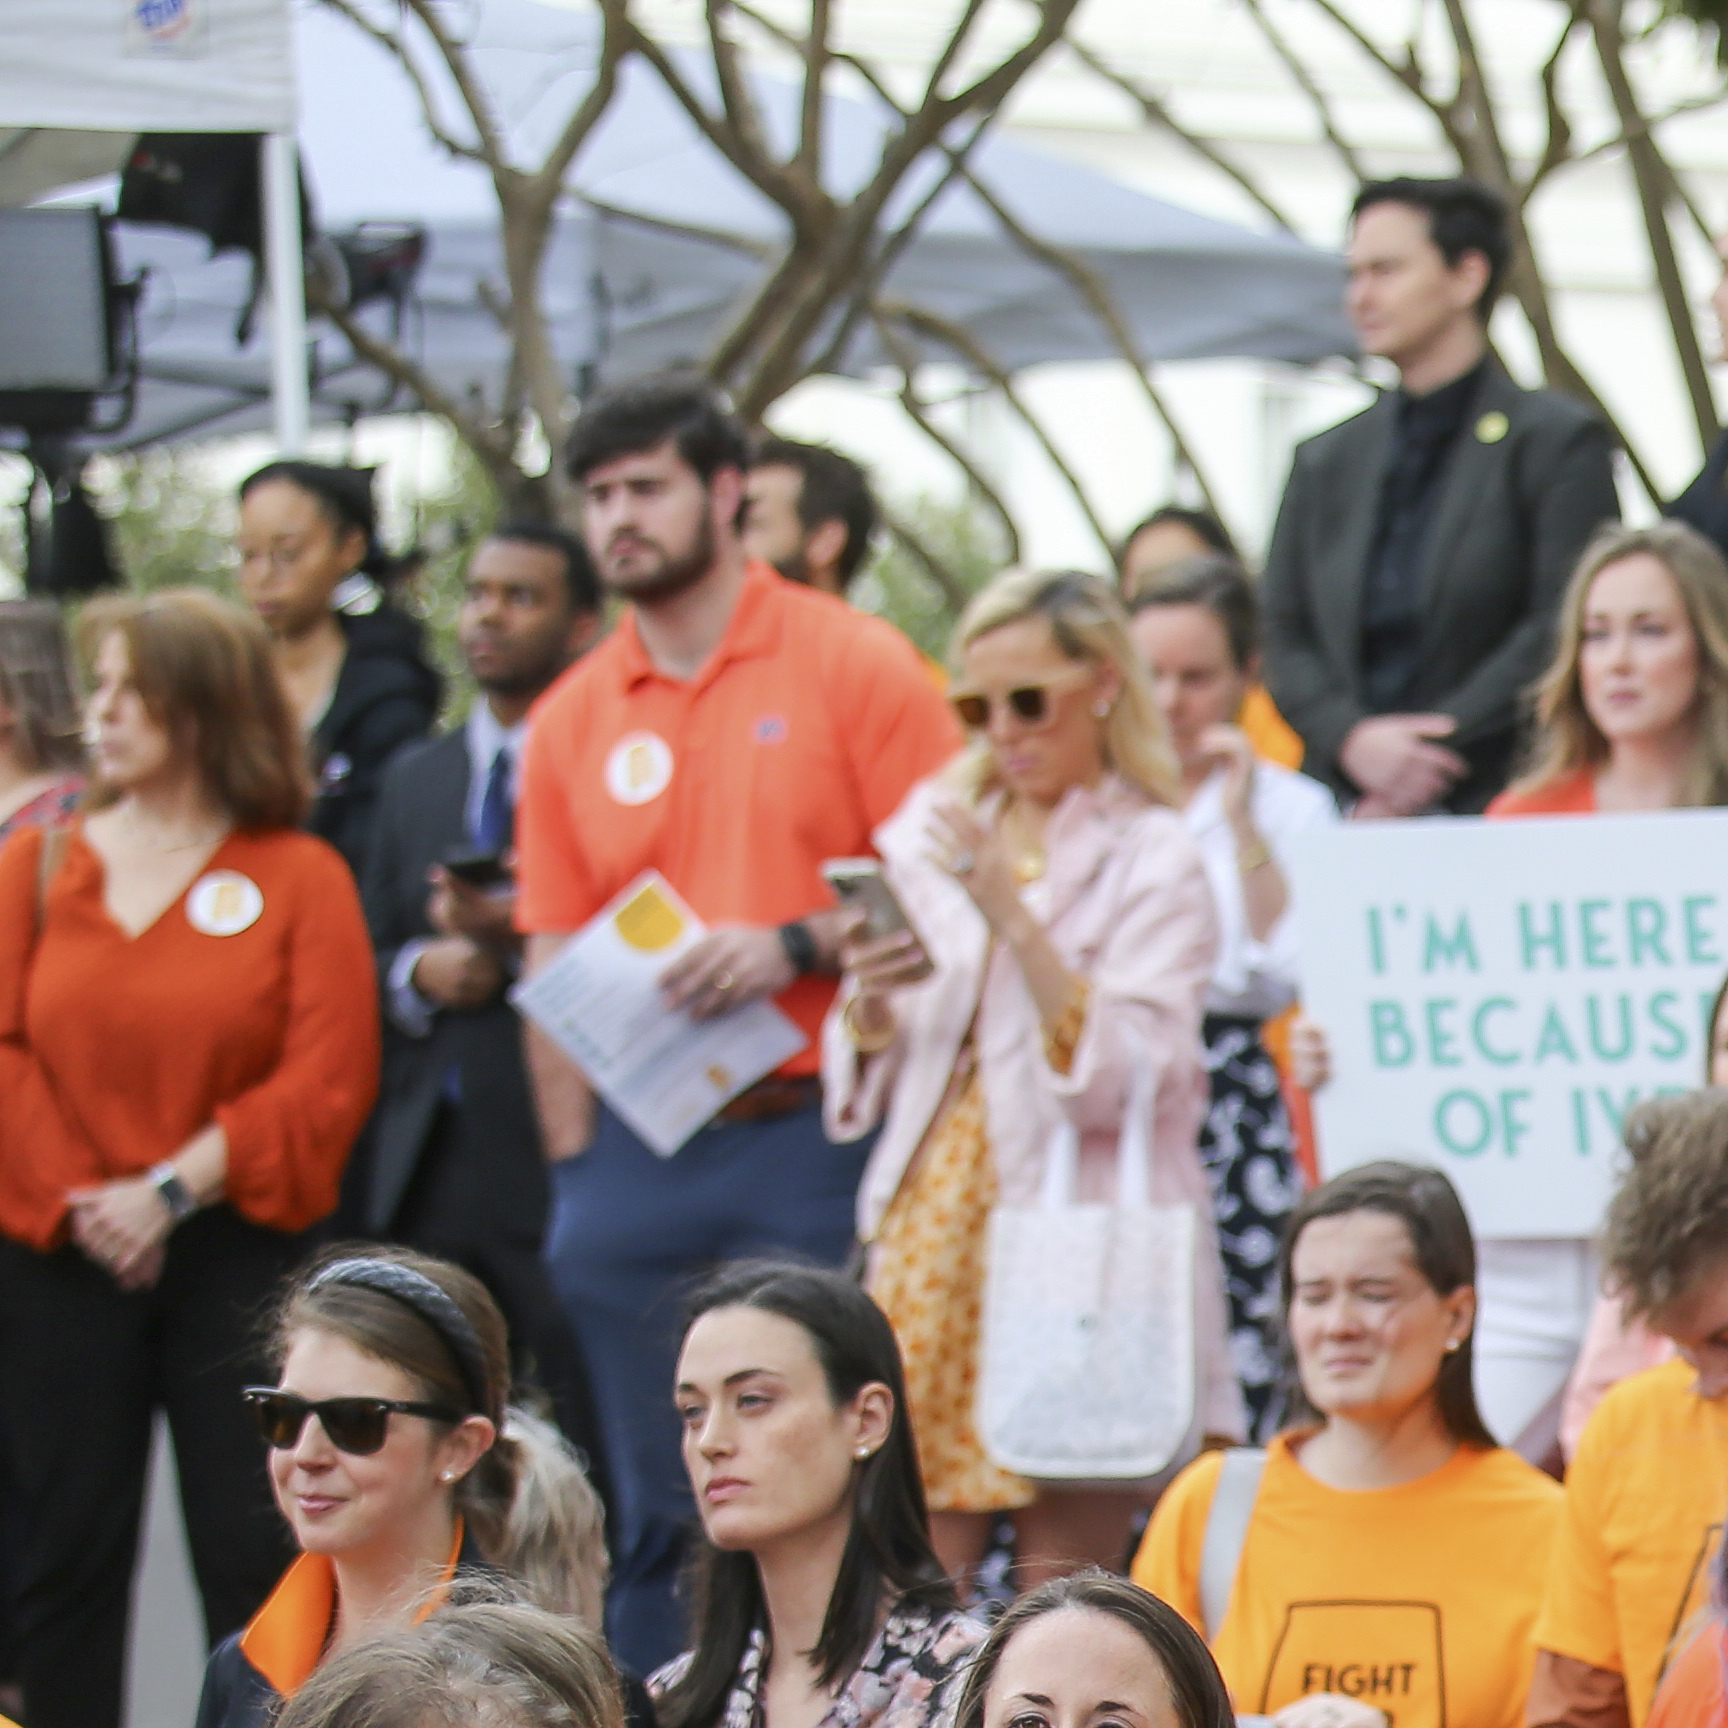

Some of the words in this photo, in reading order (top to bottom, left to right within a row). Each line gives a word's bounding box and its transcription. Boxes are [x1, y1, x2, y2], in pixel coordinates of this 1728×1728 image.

[1367, 903, 1481, 974] I'M
[1517, 894, 1721, 972] HERE
[1433, 1085, 1533, 1159] OF
[1302, 1662, 1417, 1697] FIGHT
